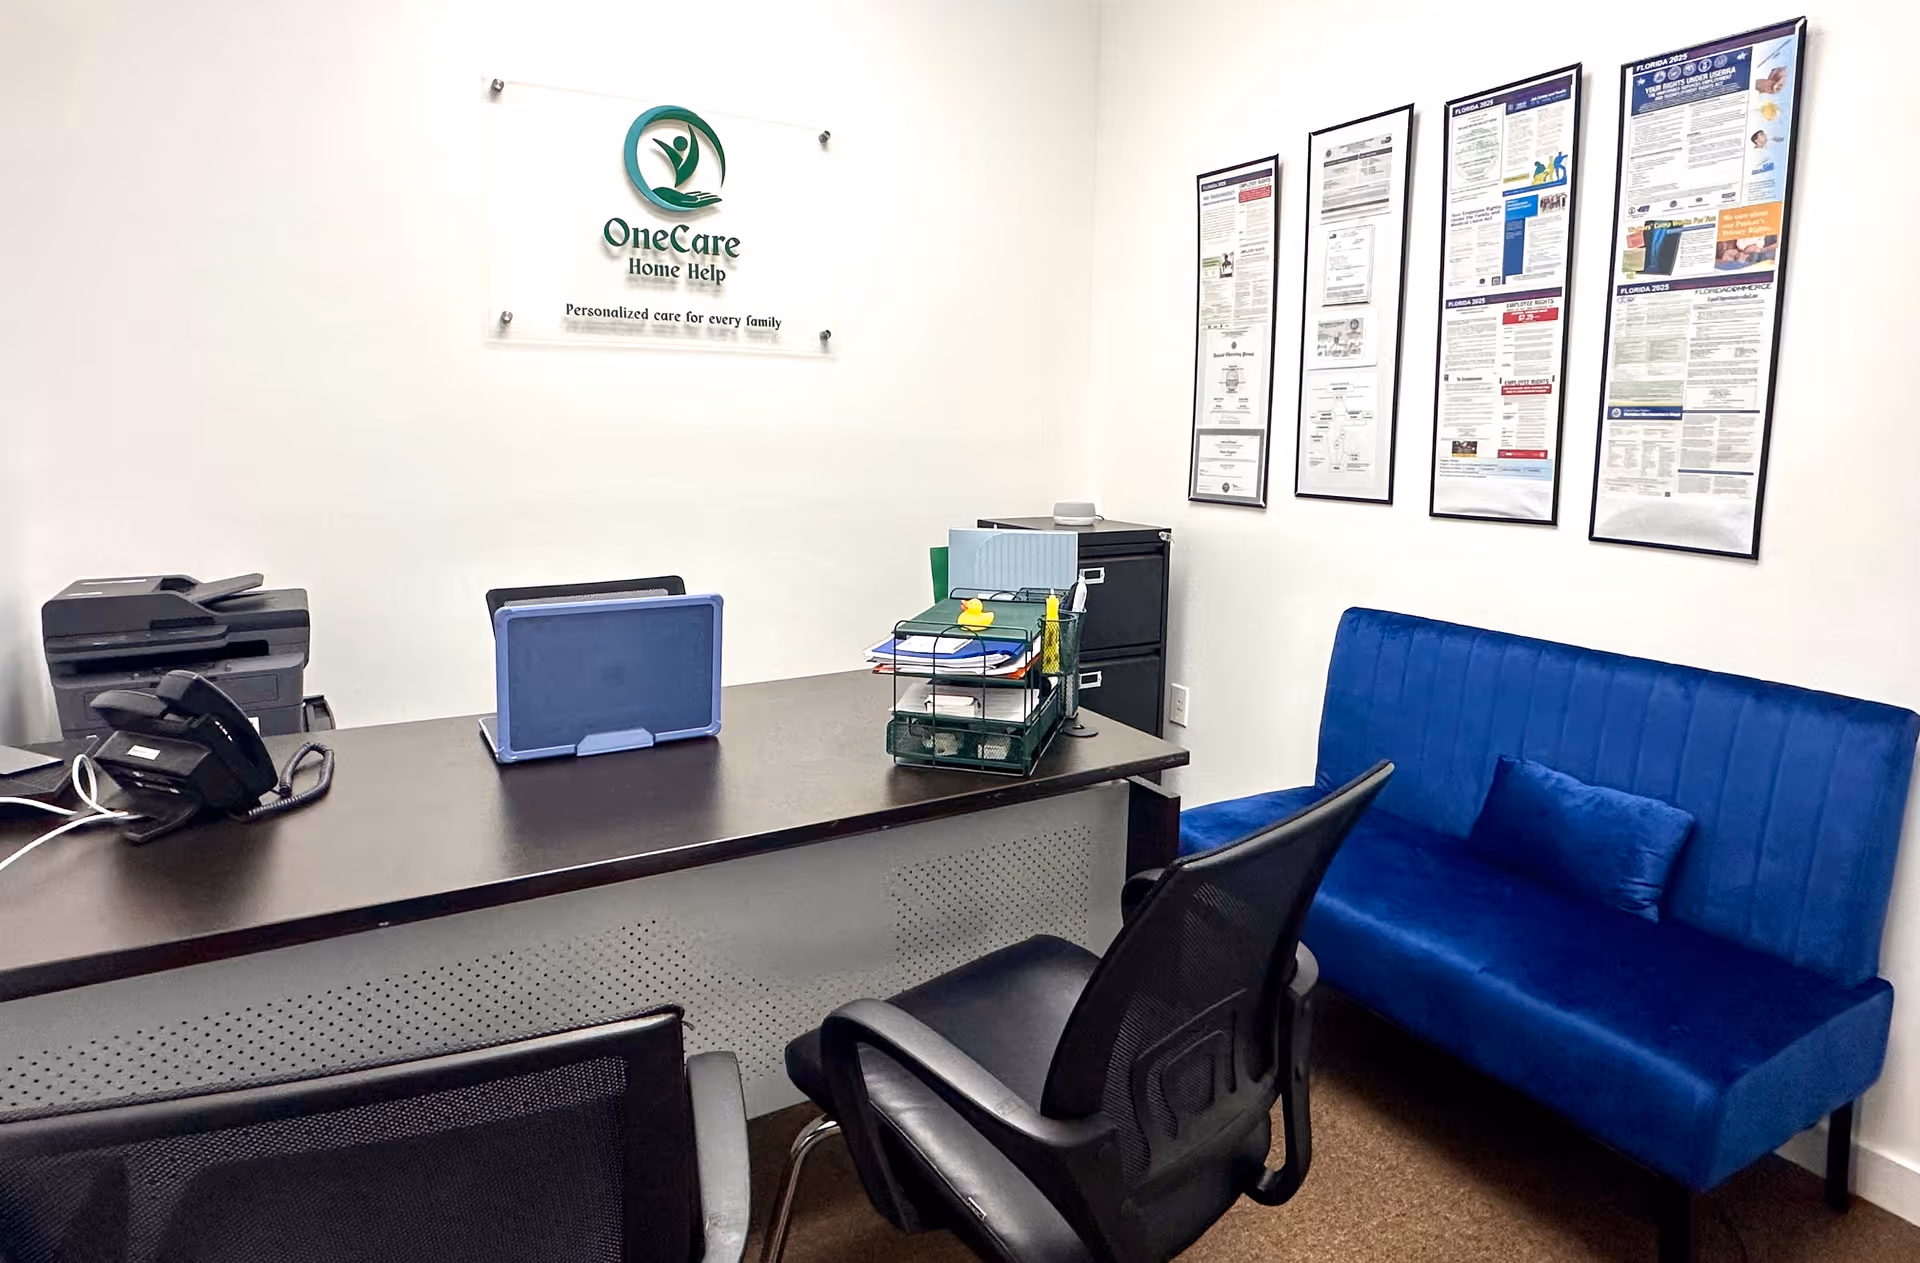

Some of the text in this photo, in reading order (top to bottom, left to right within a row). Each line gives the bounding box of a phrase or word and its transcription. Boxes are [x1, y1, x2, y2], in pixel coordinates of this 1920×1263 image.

[1636, 53, 1688, 72] FLORIDA 2025
[1663, 78, 1685, 89] RIGHTS
[1686, 73, 1708, 84] UNDER
[1455, 99, 1494, 114] FLORIDA 2025
[604, 217, 741, 258] OneCare
[629, 258, 726, 285] Home Help
[1620, 283, 1670, 295] FLORIDA 2025
[1472, 297, 1486, 305] 2025
[566, 303, 782, 330] Personalized care for every family
